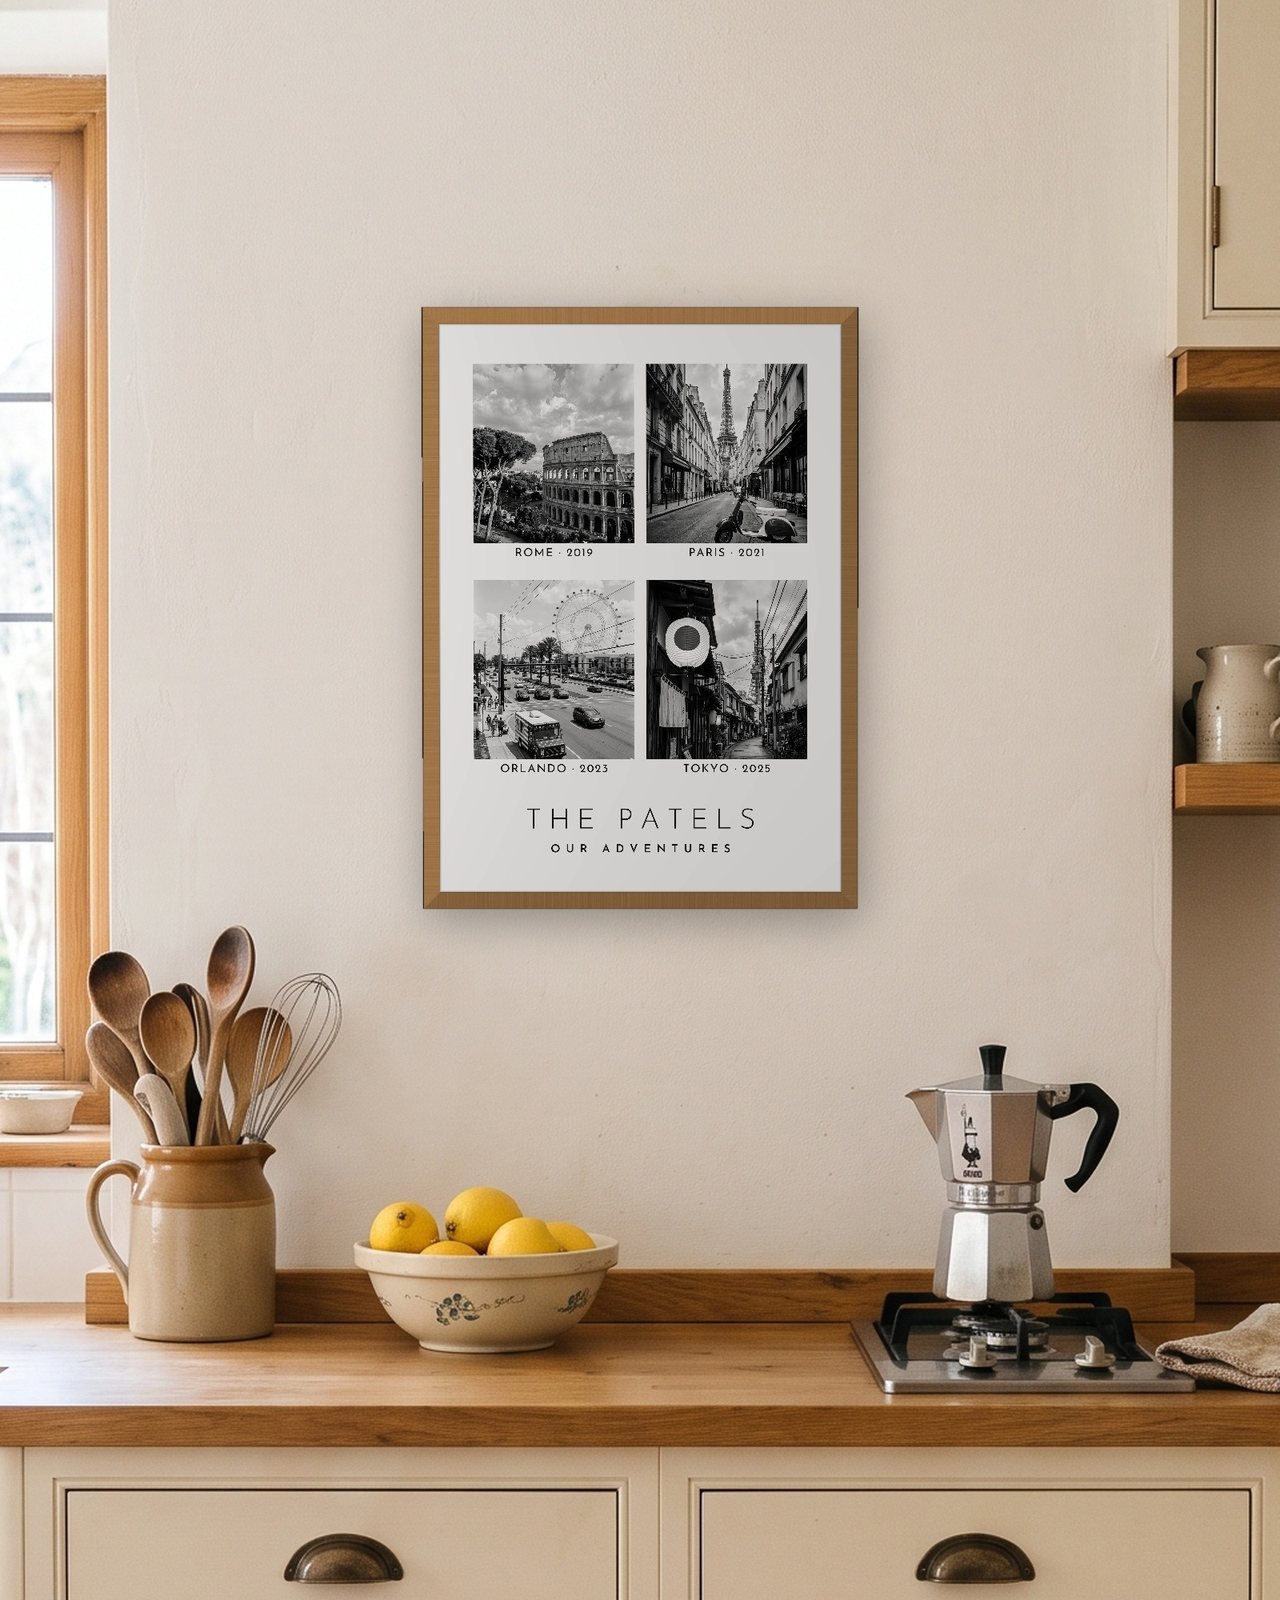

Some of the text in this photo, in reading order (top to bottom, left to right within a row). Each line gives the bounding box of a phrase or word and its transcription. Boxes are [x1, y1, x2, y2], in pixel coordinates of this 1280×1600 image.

[515, 547, 553, 557] ROME
[566, 547, 594, 557] 2019
[688, 547, 725, 557] PARIS
[738, 547, 765, 557] 2021
[500, 763, 567, 773] ORLANDO
[579, 763, 608, 773] 2023
[683, 763, 729, 773] TOKYO
[741, 763, 771, 773] 2025
[526, 807, 756, 830] THE PATELS
[550, 843, 732, 854] OUR ADVENTURES
